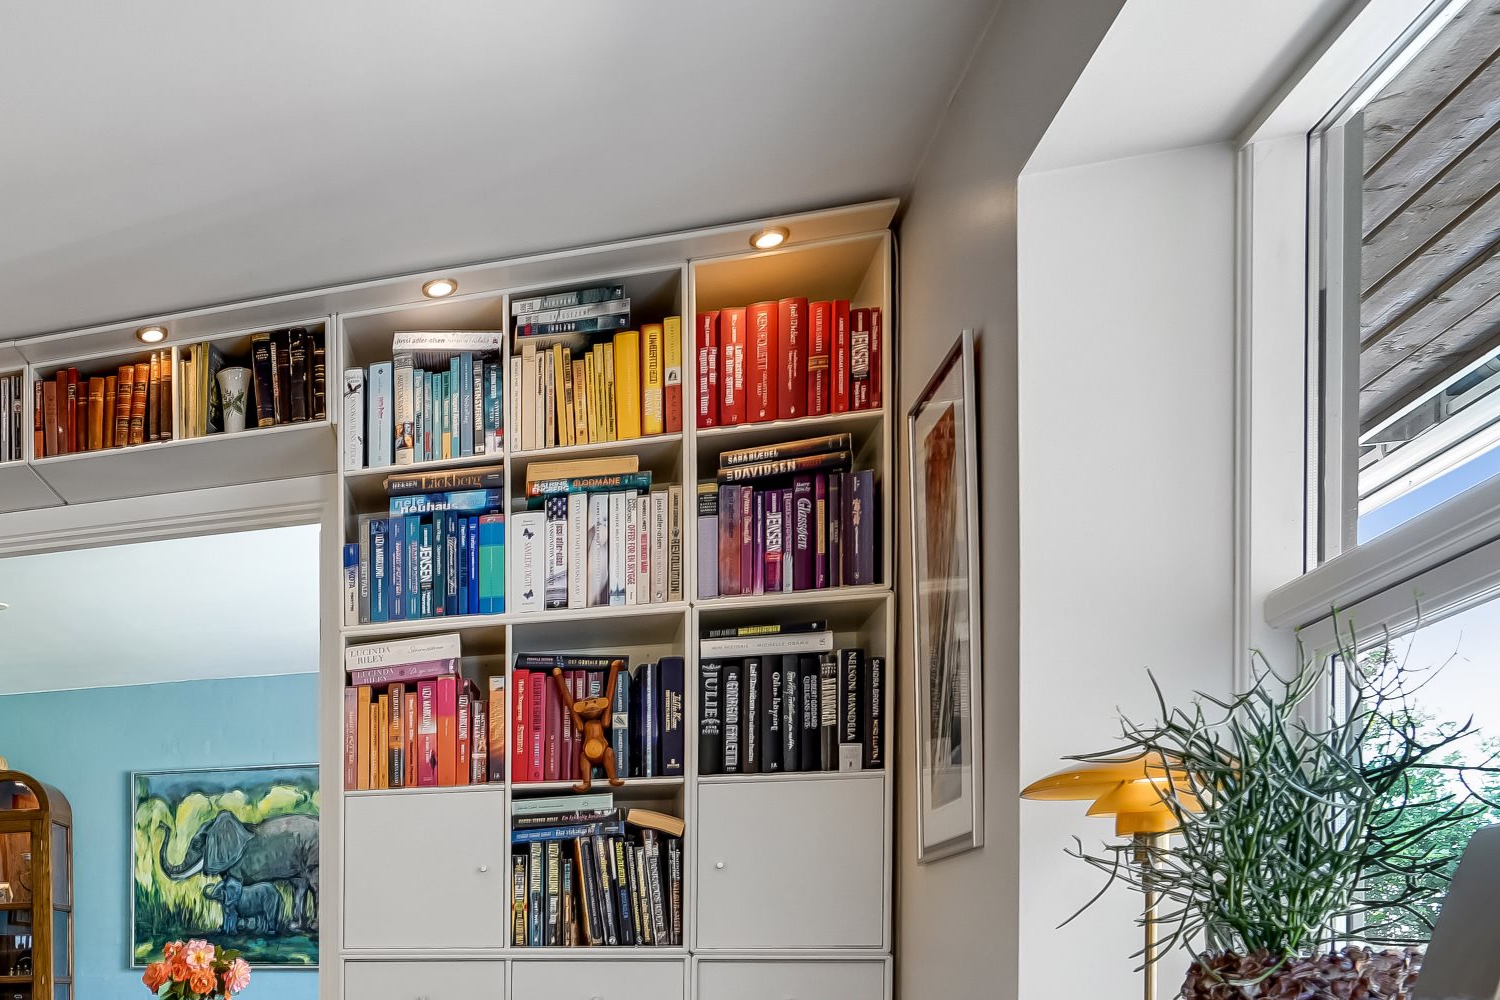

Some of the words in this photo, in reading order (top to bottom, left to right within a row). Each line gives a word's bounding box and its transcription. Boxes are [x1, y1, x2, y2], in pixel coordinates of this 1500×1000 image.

[852, 331, 868, 374] JENSEN
[644, 389, 653, 416] NAVN
[728, 453, 748, 464] SARA
[748, 450, 778, 460] BLÆDEL
[421, 474, 482, 490] Läckberg
[572, 476, 621, 488] BLODMÅNE
[734, 460, 795, 480] DAVIDSEN
[394, 497, 424, 507] nele
[400, 501, 458, 514] neuhaus
[656, 499, 664, 512] jussi
[627, 525, 635, 541] OFFER
[656, 514, 664, 549] adler-olsen
[766, 511, 781, 552] JENSEN
[798, 498, 811, 550] Glassøen
[524, 542, 532, 569] SAMLEDE
[627, 543, 635, 554] FOR
[420, 547, 432, 582] JENSEN
[627, 563, 635, 585] SKYGGE
[671, 539, 680, 593] REVOLUTION
[524, 570, 532, 588] DIGTE
[350, 646, 390, 658] LUCINDA
[357, 654, 384, 664] RILEY
[356, 668, 394, 678] LUCINDA
[848, 652, 856, 689] NELSON
[703, 672, 717, 718] JULIE
[726, 681, 738, 723] GIORGIO
[459, 709, 468, 740] MARKLUND
[848, 692, 856, 740] MANDELA
[726, 724, 738, 766] FALETTI
